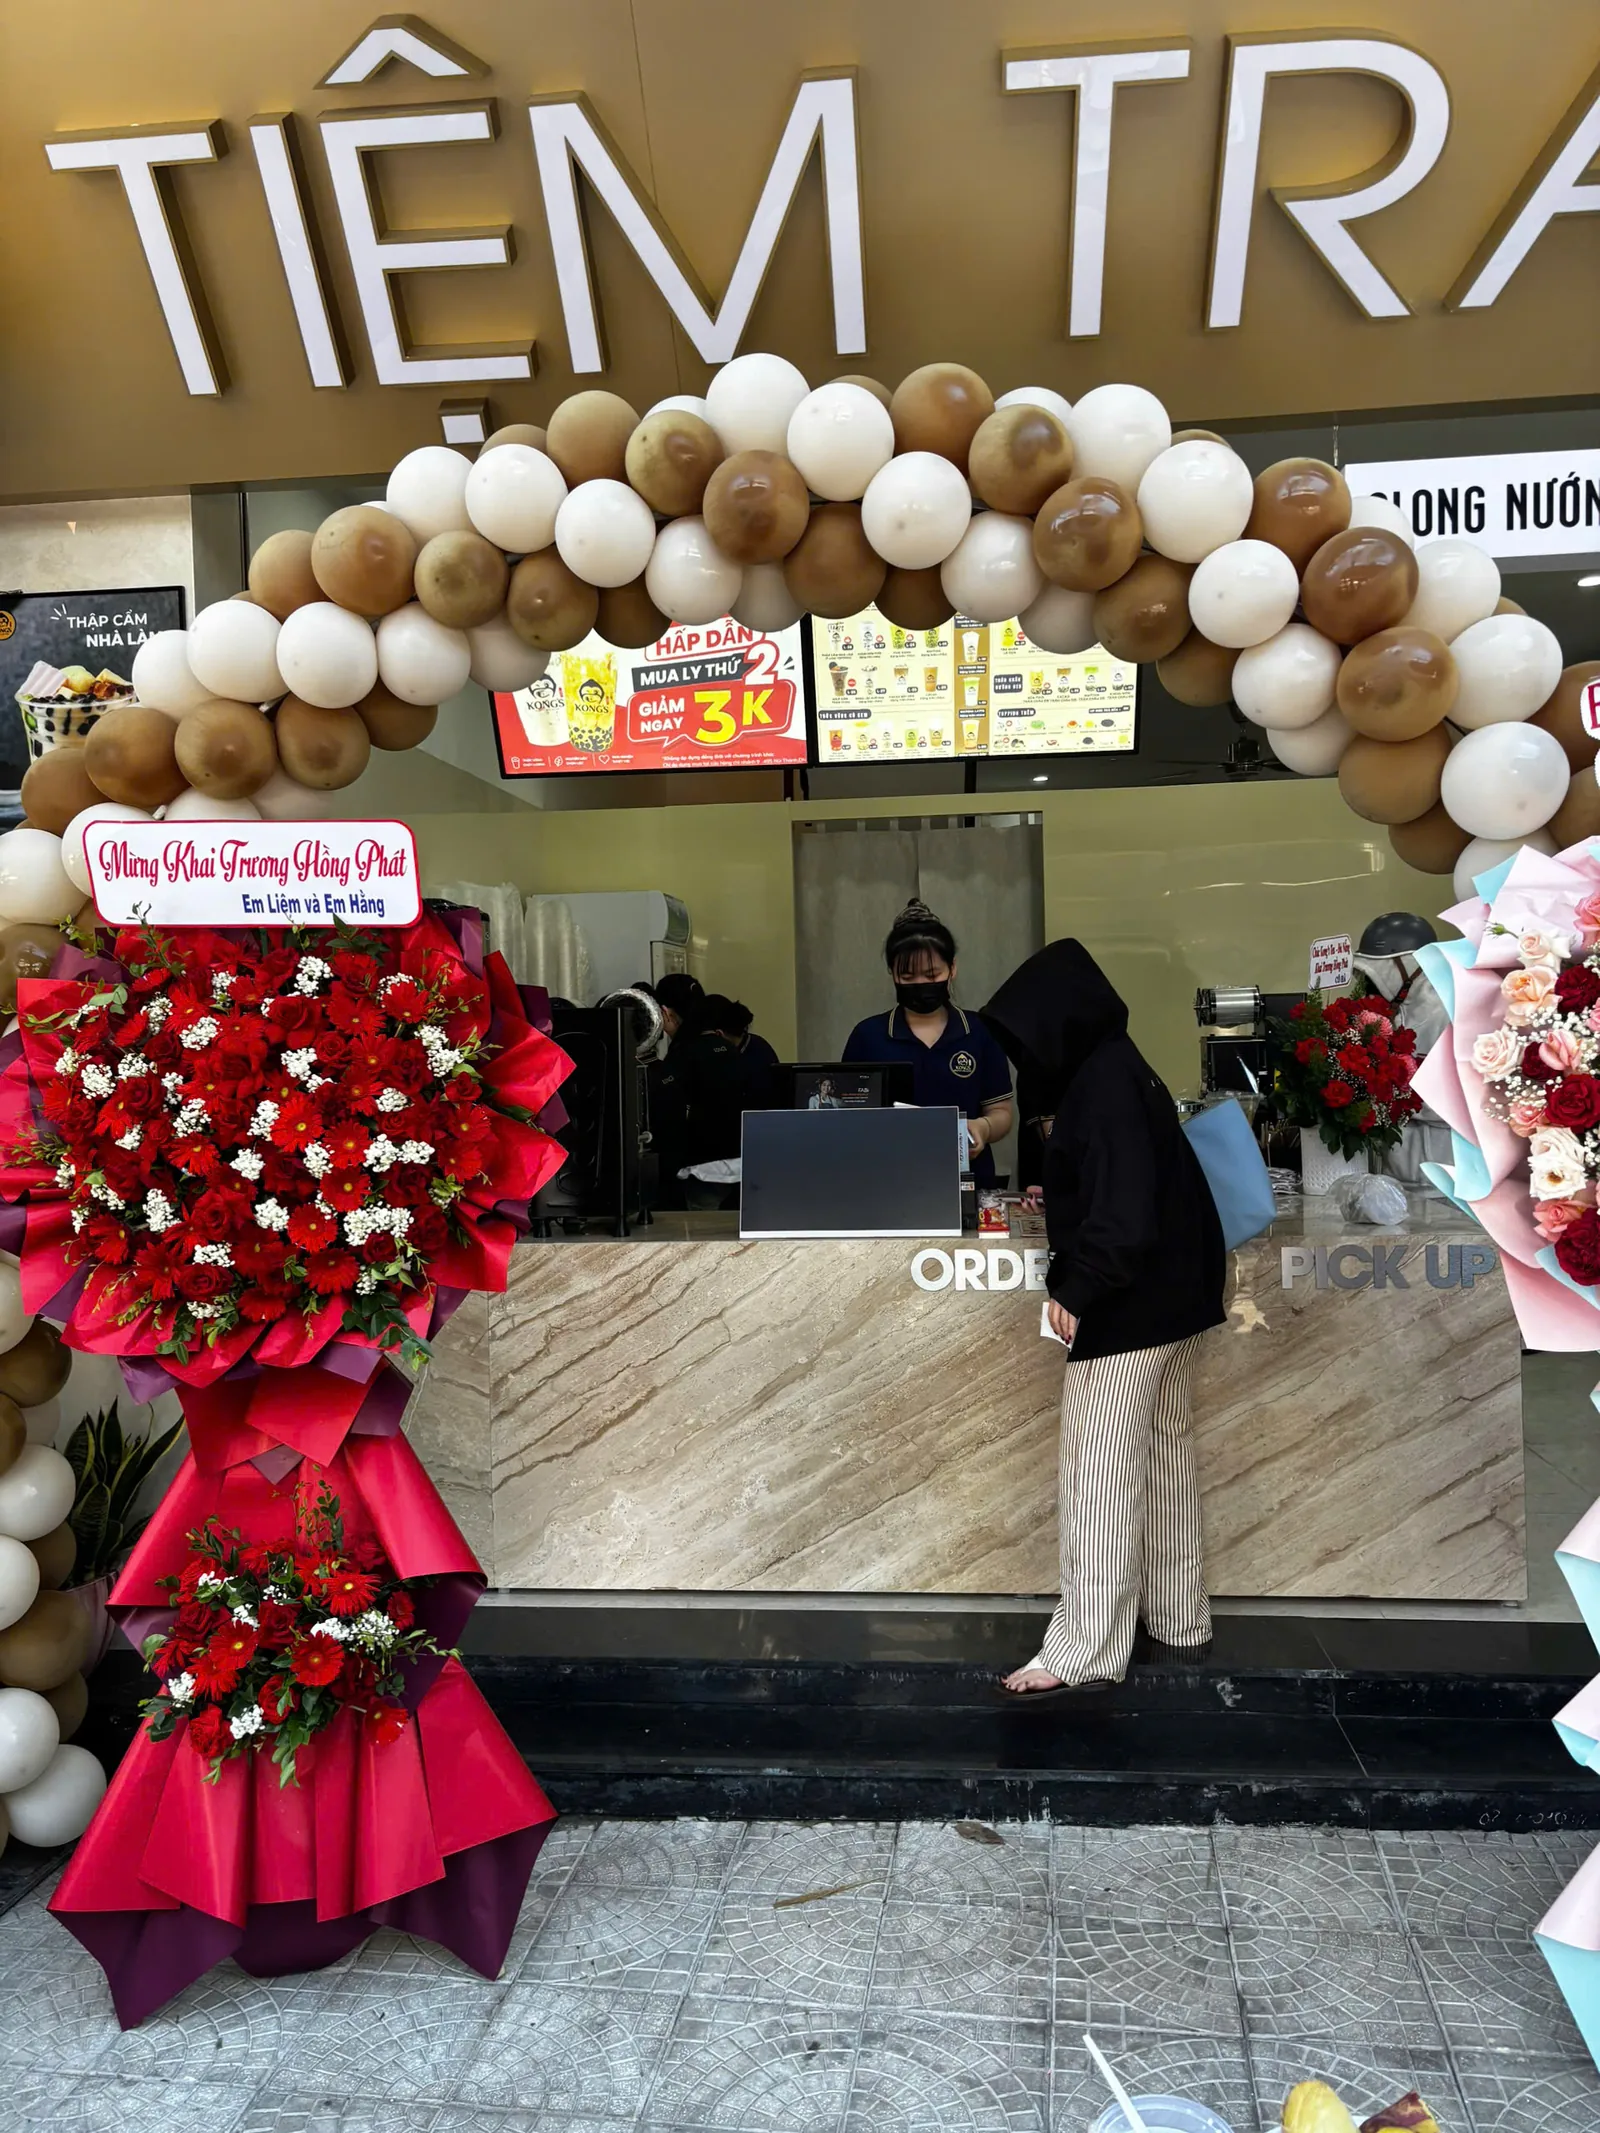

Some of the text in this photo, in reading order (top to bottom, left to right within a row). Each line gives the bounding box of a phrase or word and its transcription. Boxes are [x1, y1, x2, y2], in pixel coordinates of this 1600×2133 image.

[44, 16, 868, 446] TIỆM
[1369, 485, 1486, 537] ONG
[67, 609, 148, 631] THẬP CẨM
[86, 629, 160, 648] NHÀ LÀ
[655, 619, 754, 656] HẤP DẪN
[640, 640, 779, 687] MUA LY THỨ 2
[638, 695, 686, 717] GIẢM
[640, 717, 684, 734] NGAY
[99, 840, 159, 887] Mừng
[163, 840, 216, 884] Khai
[294, 839, 351, 887] Hồng
[355, 839, 408, 882] Phát
[242, 893, 265, 914] Em
[304, 893, 321, 913] và
[324, 893, 346, 914] Em
[349, 889, 385, 918] Hằng
[1281, 1244, 1496, 1290] PICK UP
